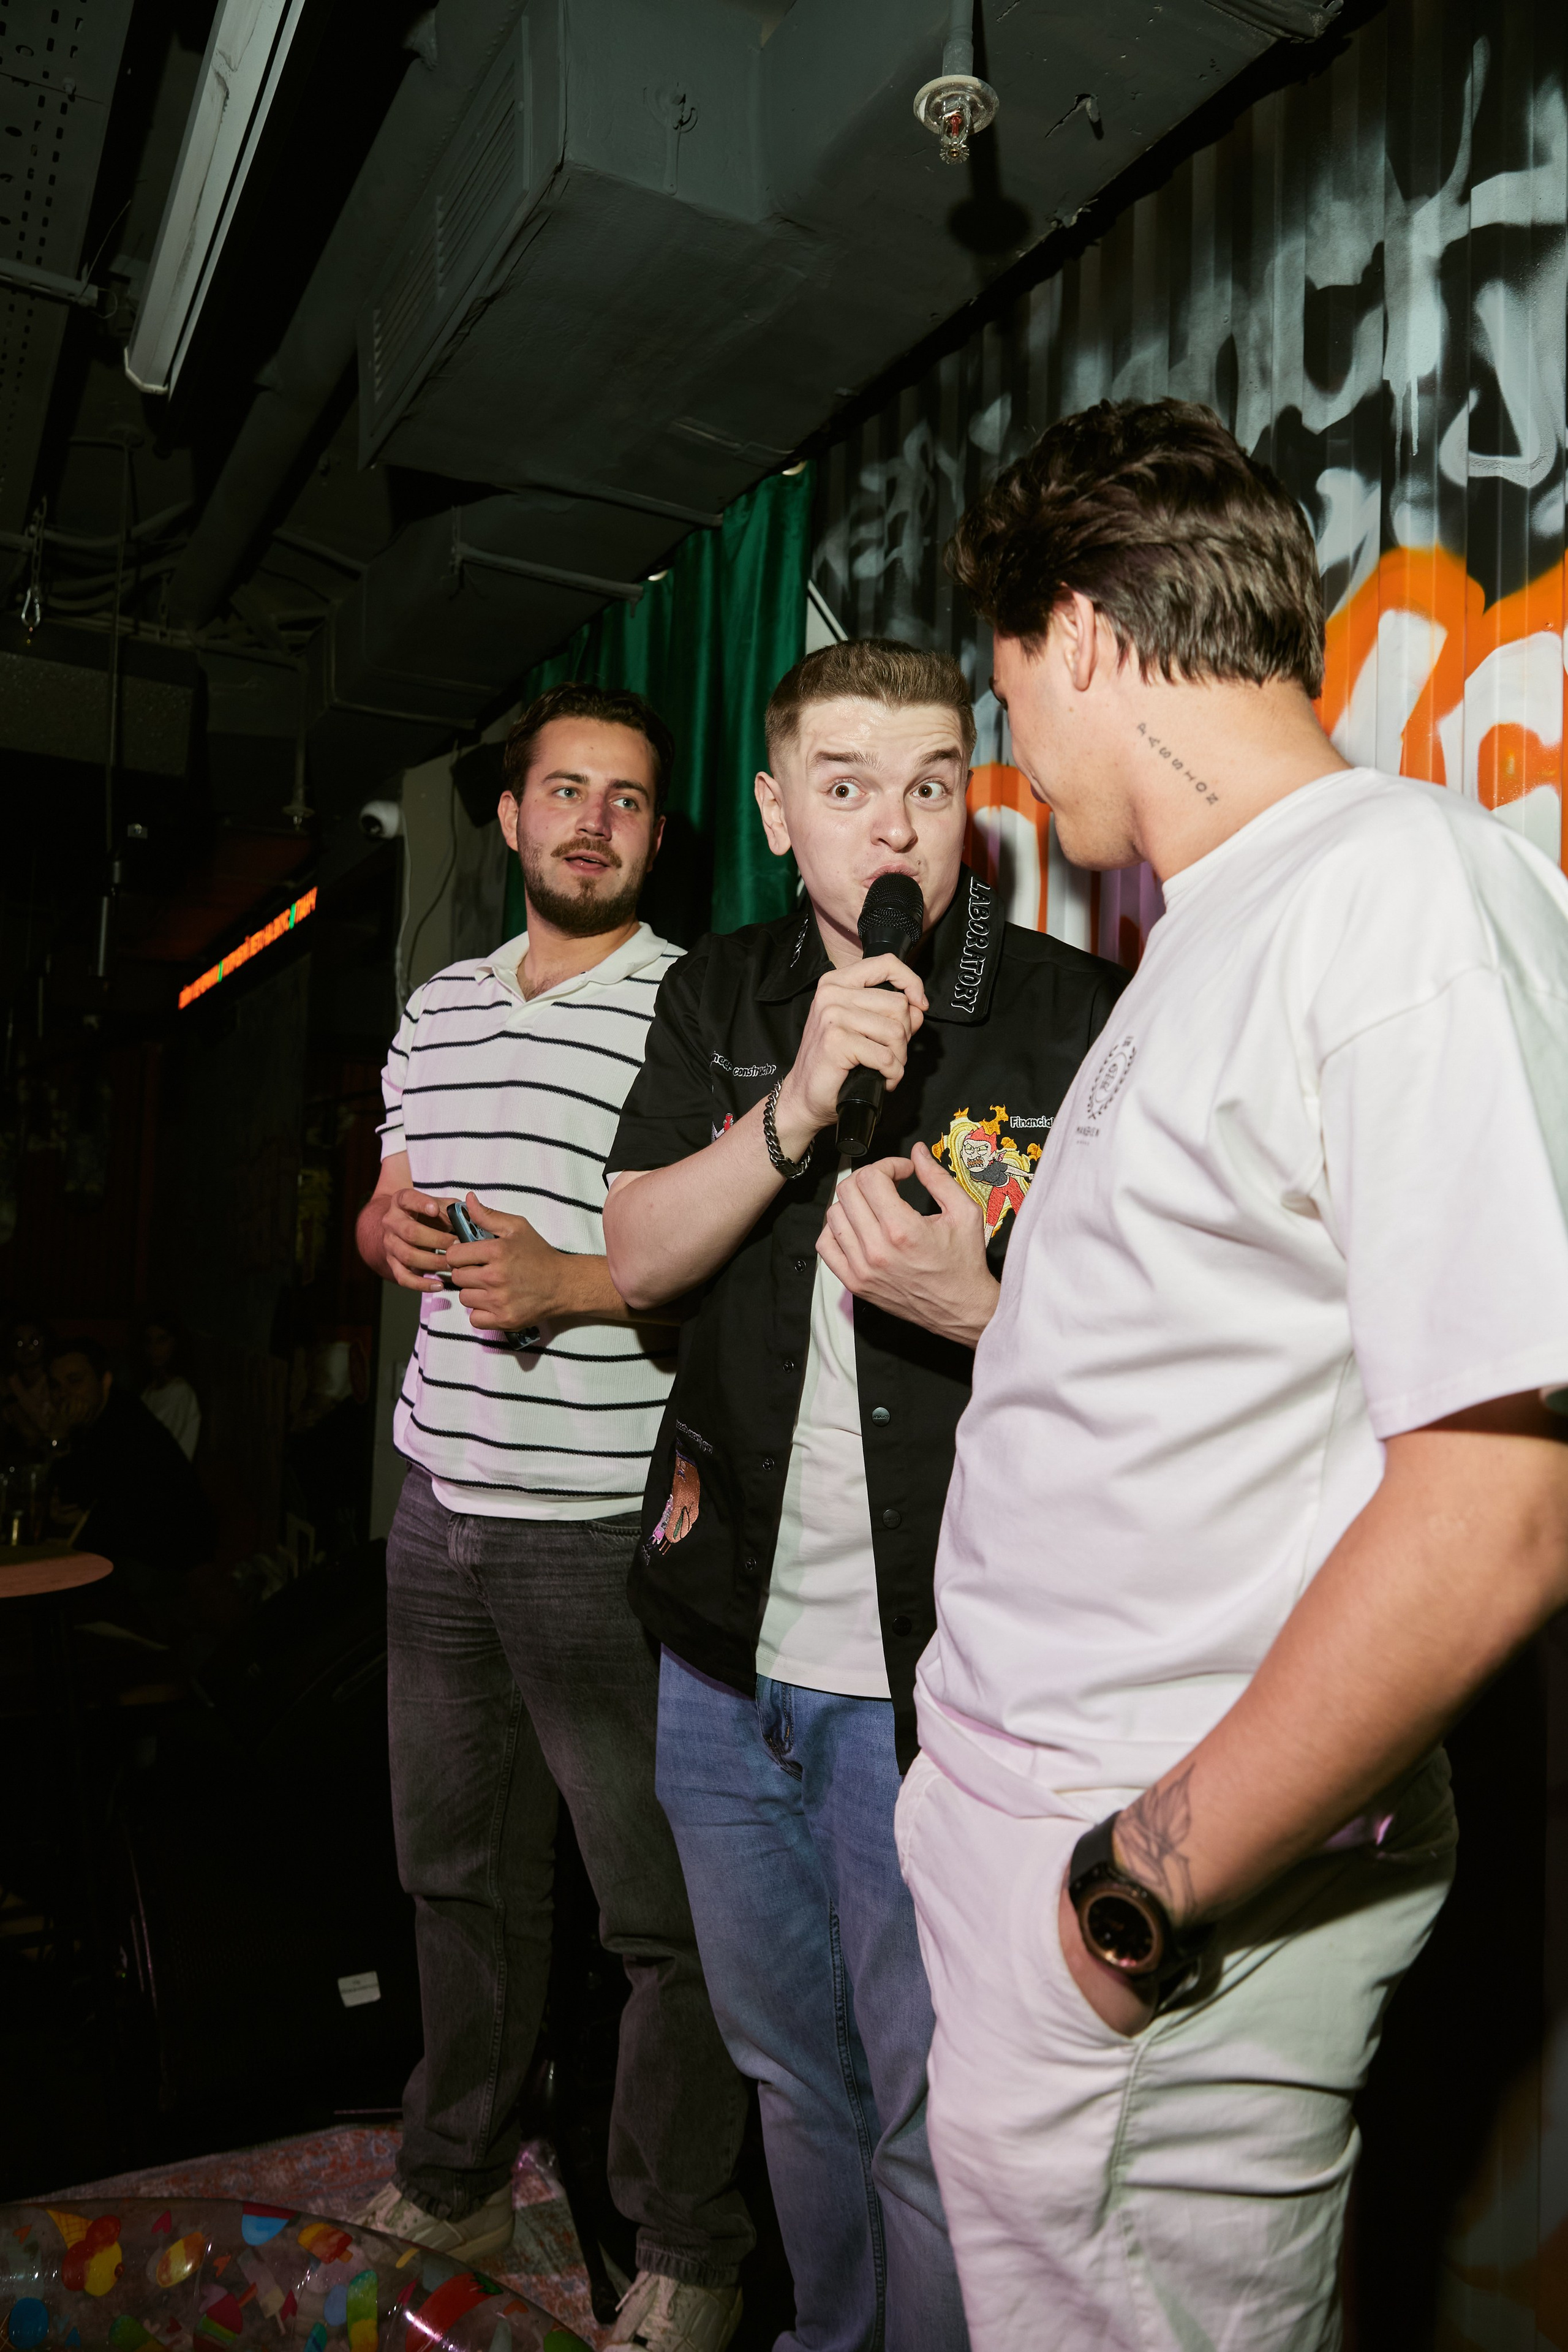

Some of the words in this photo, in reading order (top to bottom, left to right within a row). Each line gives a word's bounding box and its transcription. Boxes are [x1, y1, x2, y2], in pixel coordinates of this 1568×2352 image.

[1136, 722, 1219, 805] PASSION
[951, 876, 991, 1014] LABORATORY
[733, 1063, 777, 1077] constructor
